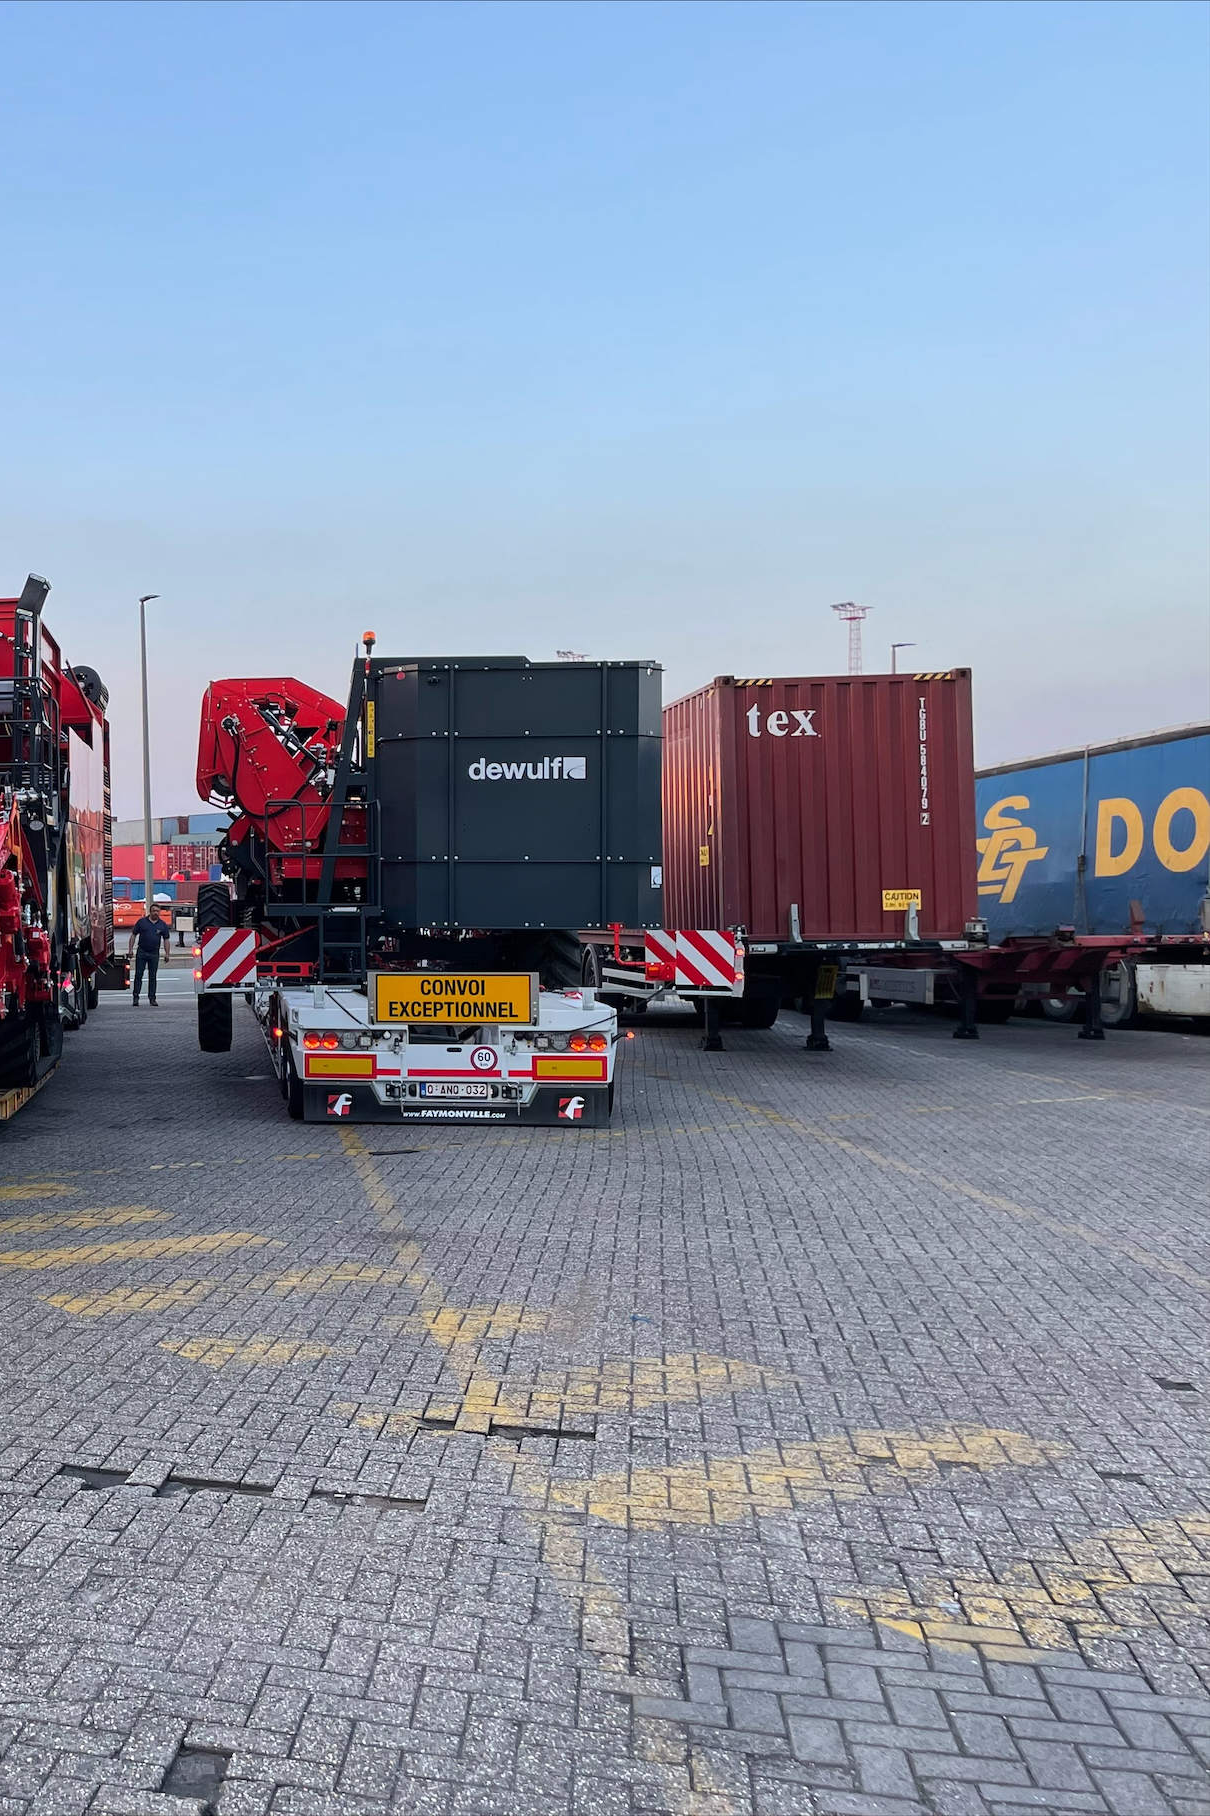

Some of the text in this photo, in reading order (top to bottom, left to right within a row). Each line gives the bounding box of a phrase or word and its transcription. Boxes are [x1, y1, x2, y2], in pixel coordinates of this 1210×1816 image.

[468, 757, 562, 780] dewulf
[920, 744, 928, 809] 584079
[921, 813, 929, 825] 2
[1095, 787, 1210, 877] DO
[420, 980, 485, 995] CONVOI
[389, 1001, 518, 1017] EXCEPTIONNEL
[477, 1052, 490, 1061] 60
